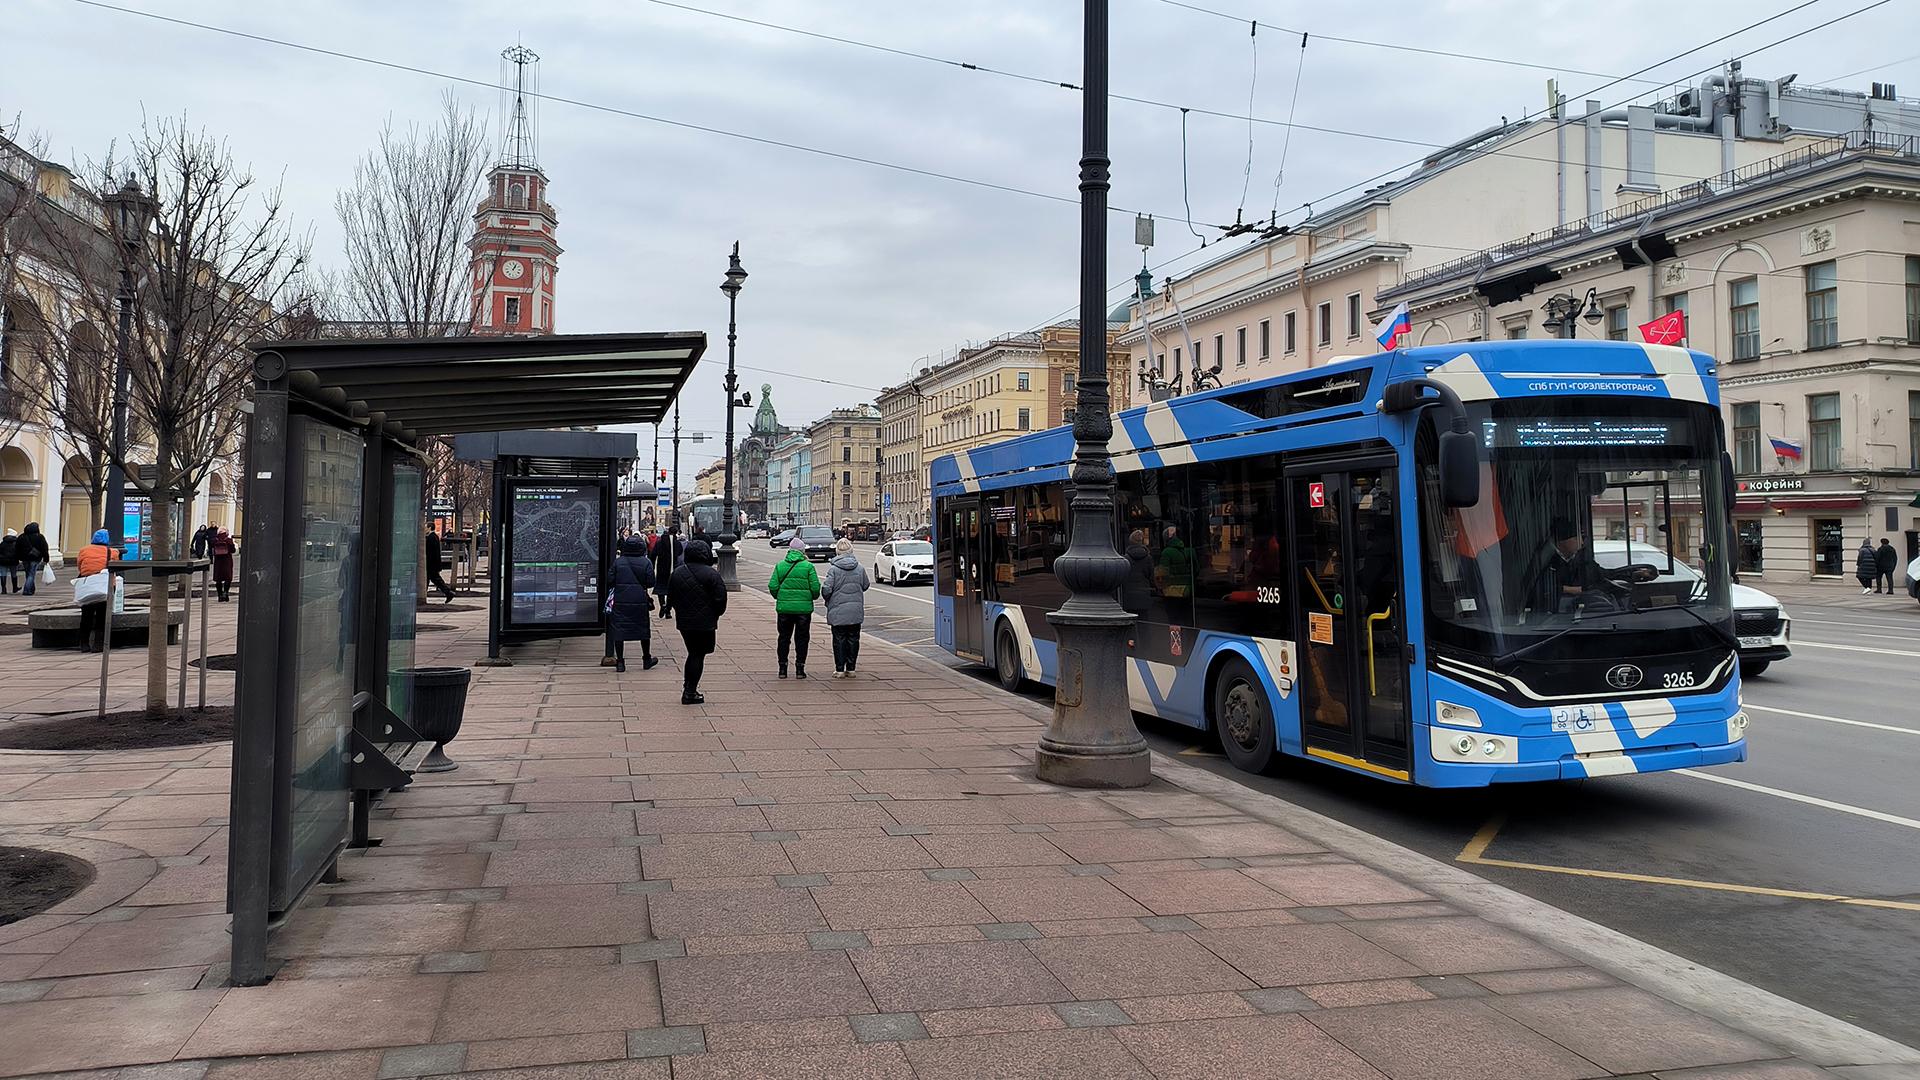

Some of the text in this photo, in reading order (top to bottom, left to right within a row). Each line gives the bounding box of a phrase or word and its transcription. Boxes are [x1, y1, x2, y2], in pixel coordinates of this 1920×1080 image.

[1549, 382, 1568, 391] ГУП
[1569, 382, 1657, 392] «ГОРЭЛЕКТРОТРАНС»
[1750, 479, 1802, 491] кофейня
[1256, 586, 1281, 604] 3265
[1663, 671, 1695, 689] 3265
